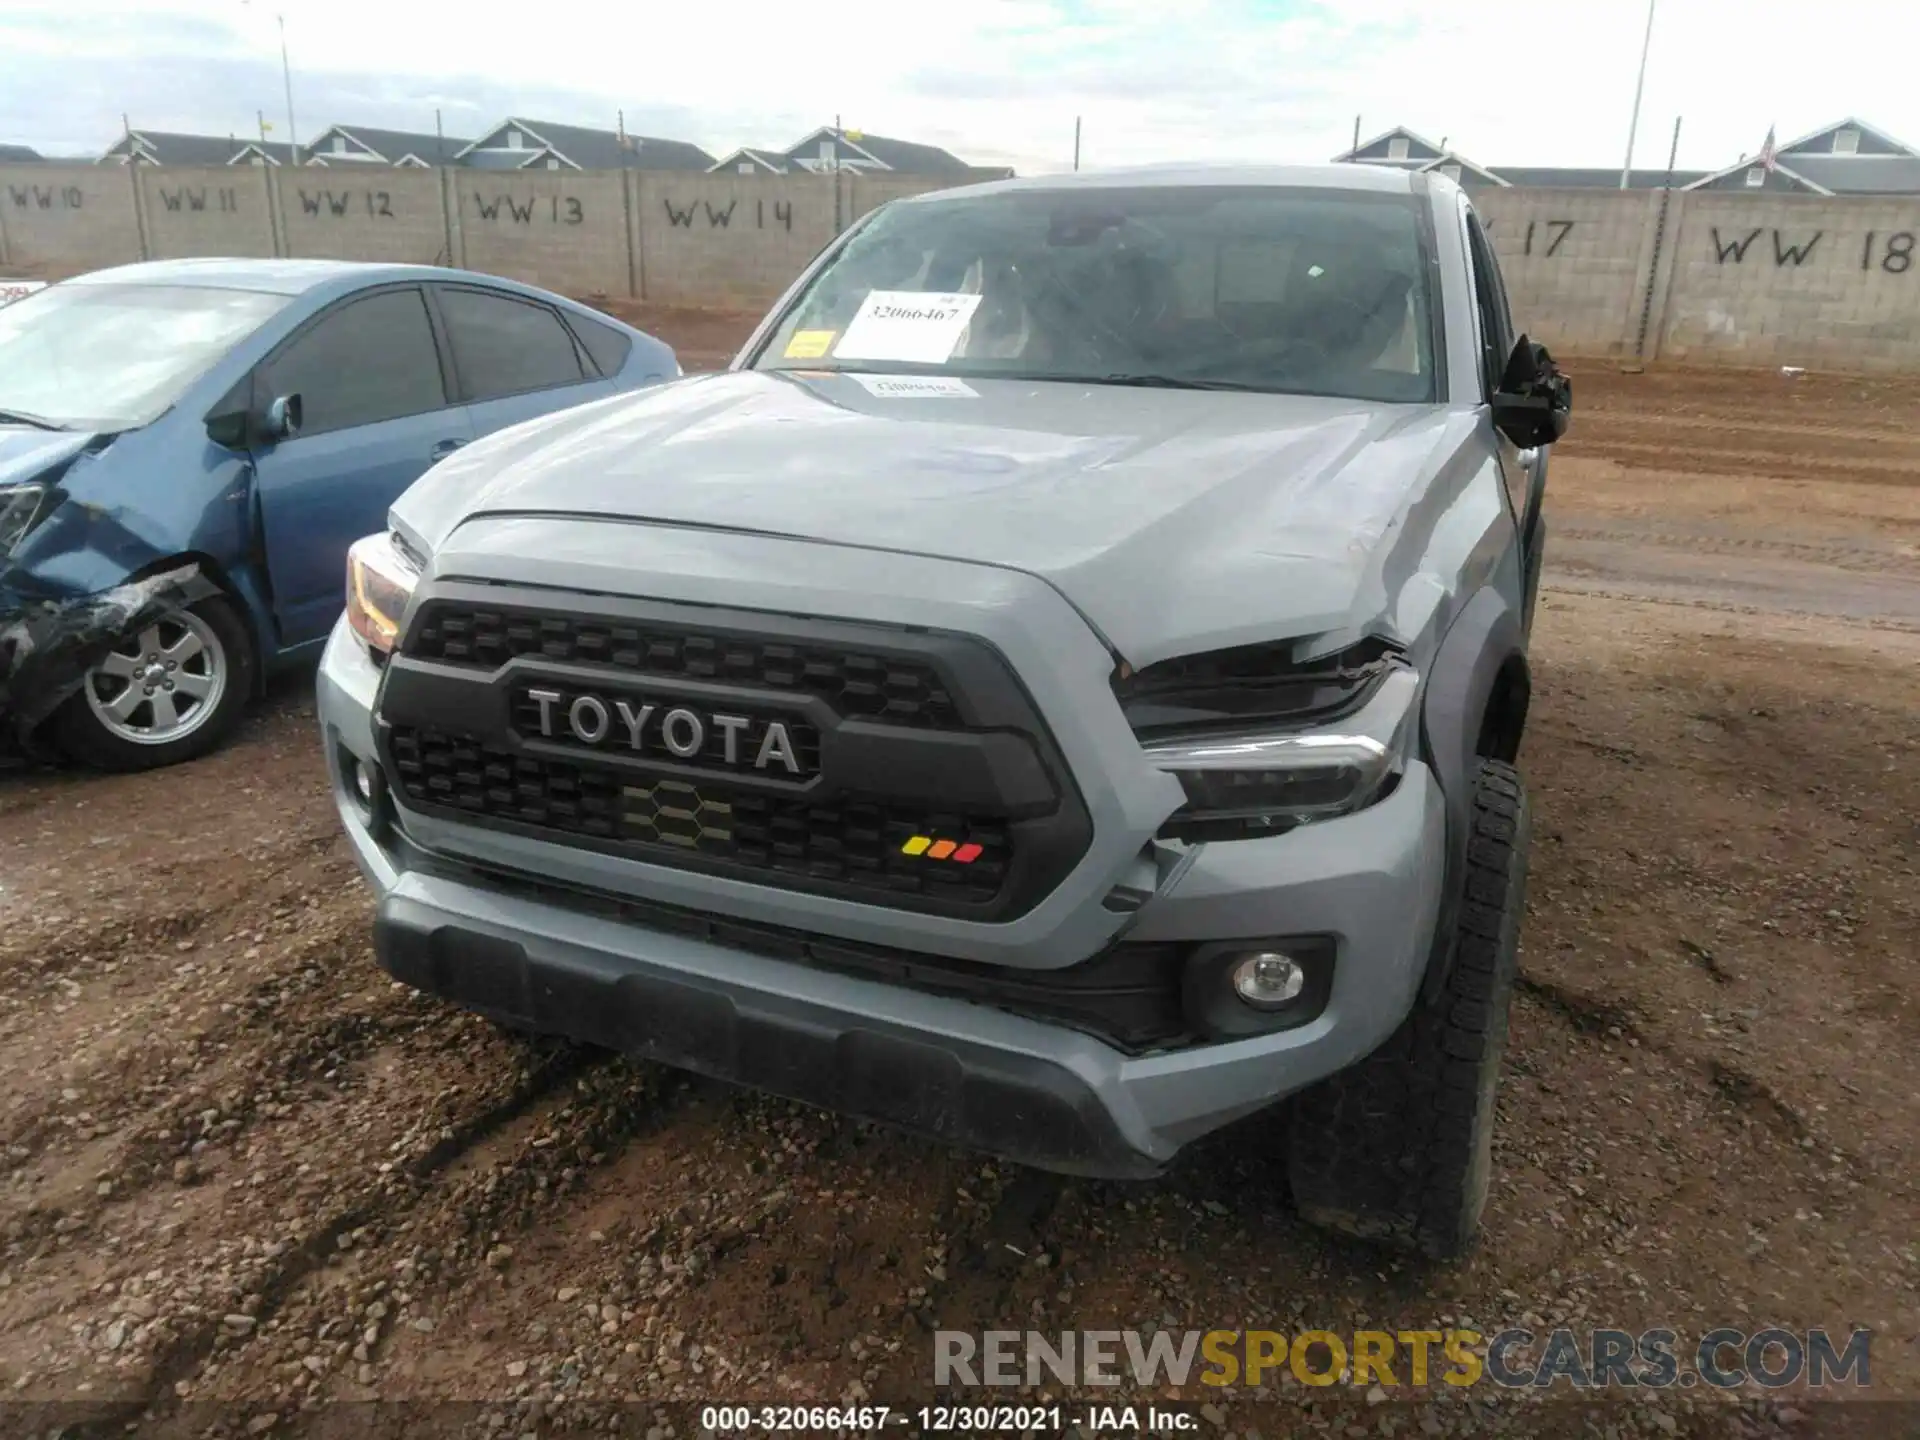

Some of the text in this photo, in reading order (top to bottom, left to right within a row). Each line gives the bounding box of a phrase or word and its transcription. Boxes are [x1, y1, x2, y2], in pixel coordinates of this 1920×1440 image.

[8, 184, 82, 209] WW 10
[160, 187, 237, 212] WW 11
[299, 190, 394, 219] WW 12
[474, 192, 583, 225] WW 13
[664, 199, 792, 232] WW 14
[1525, 220, 1574, 257] 17
[1712, 228, 1916, 274] WW 18
[529, 689, 799, 773] TOYOTA
